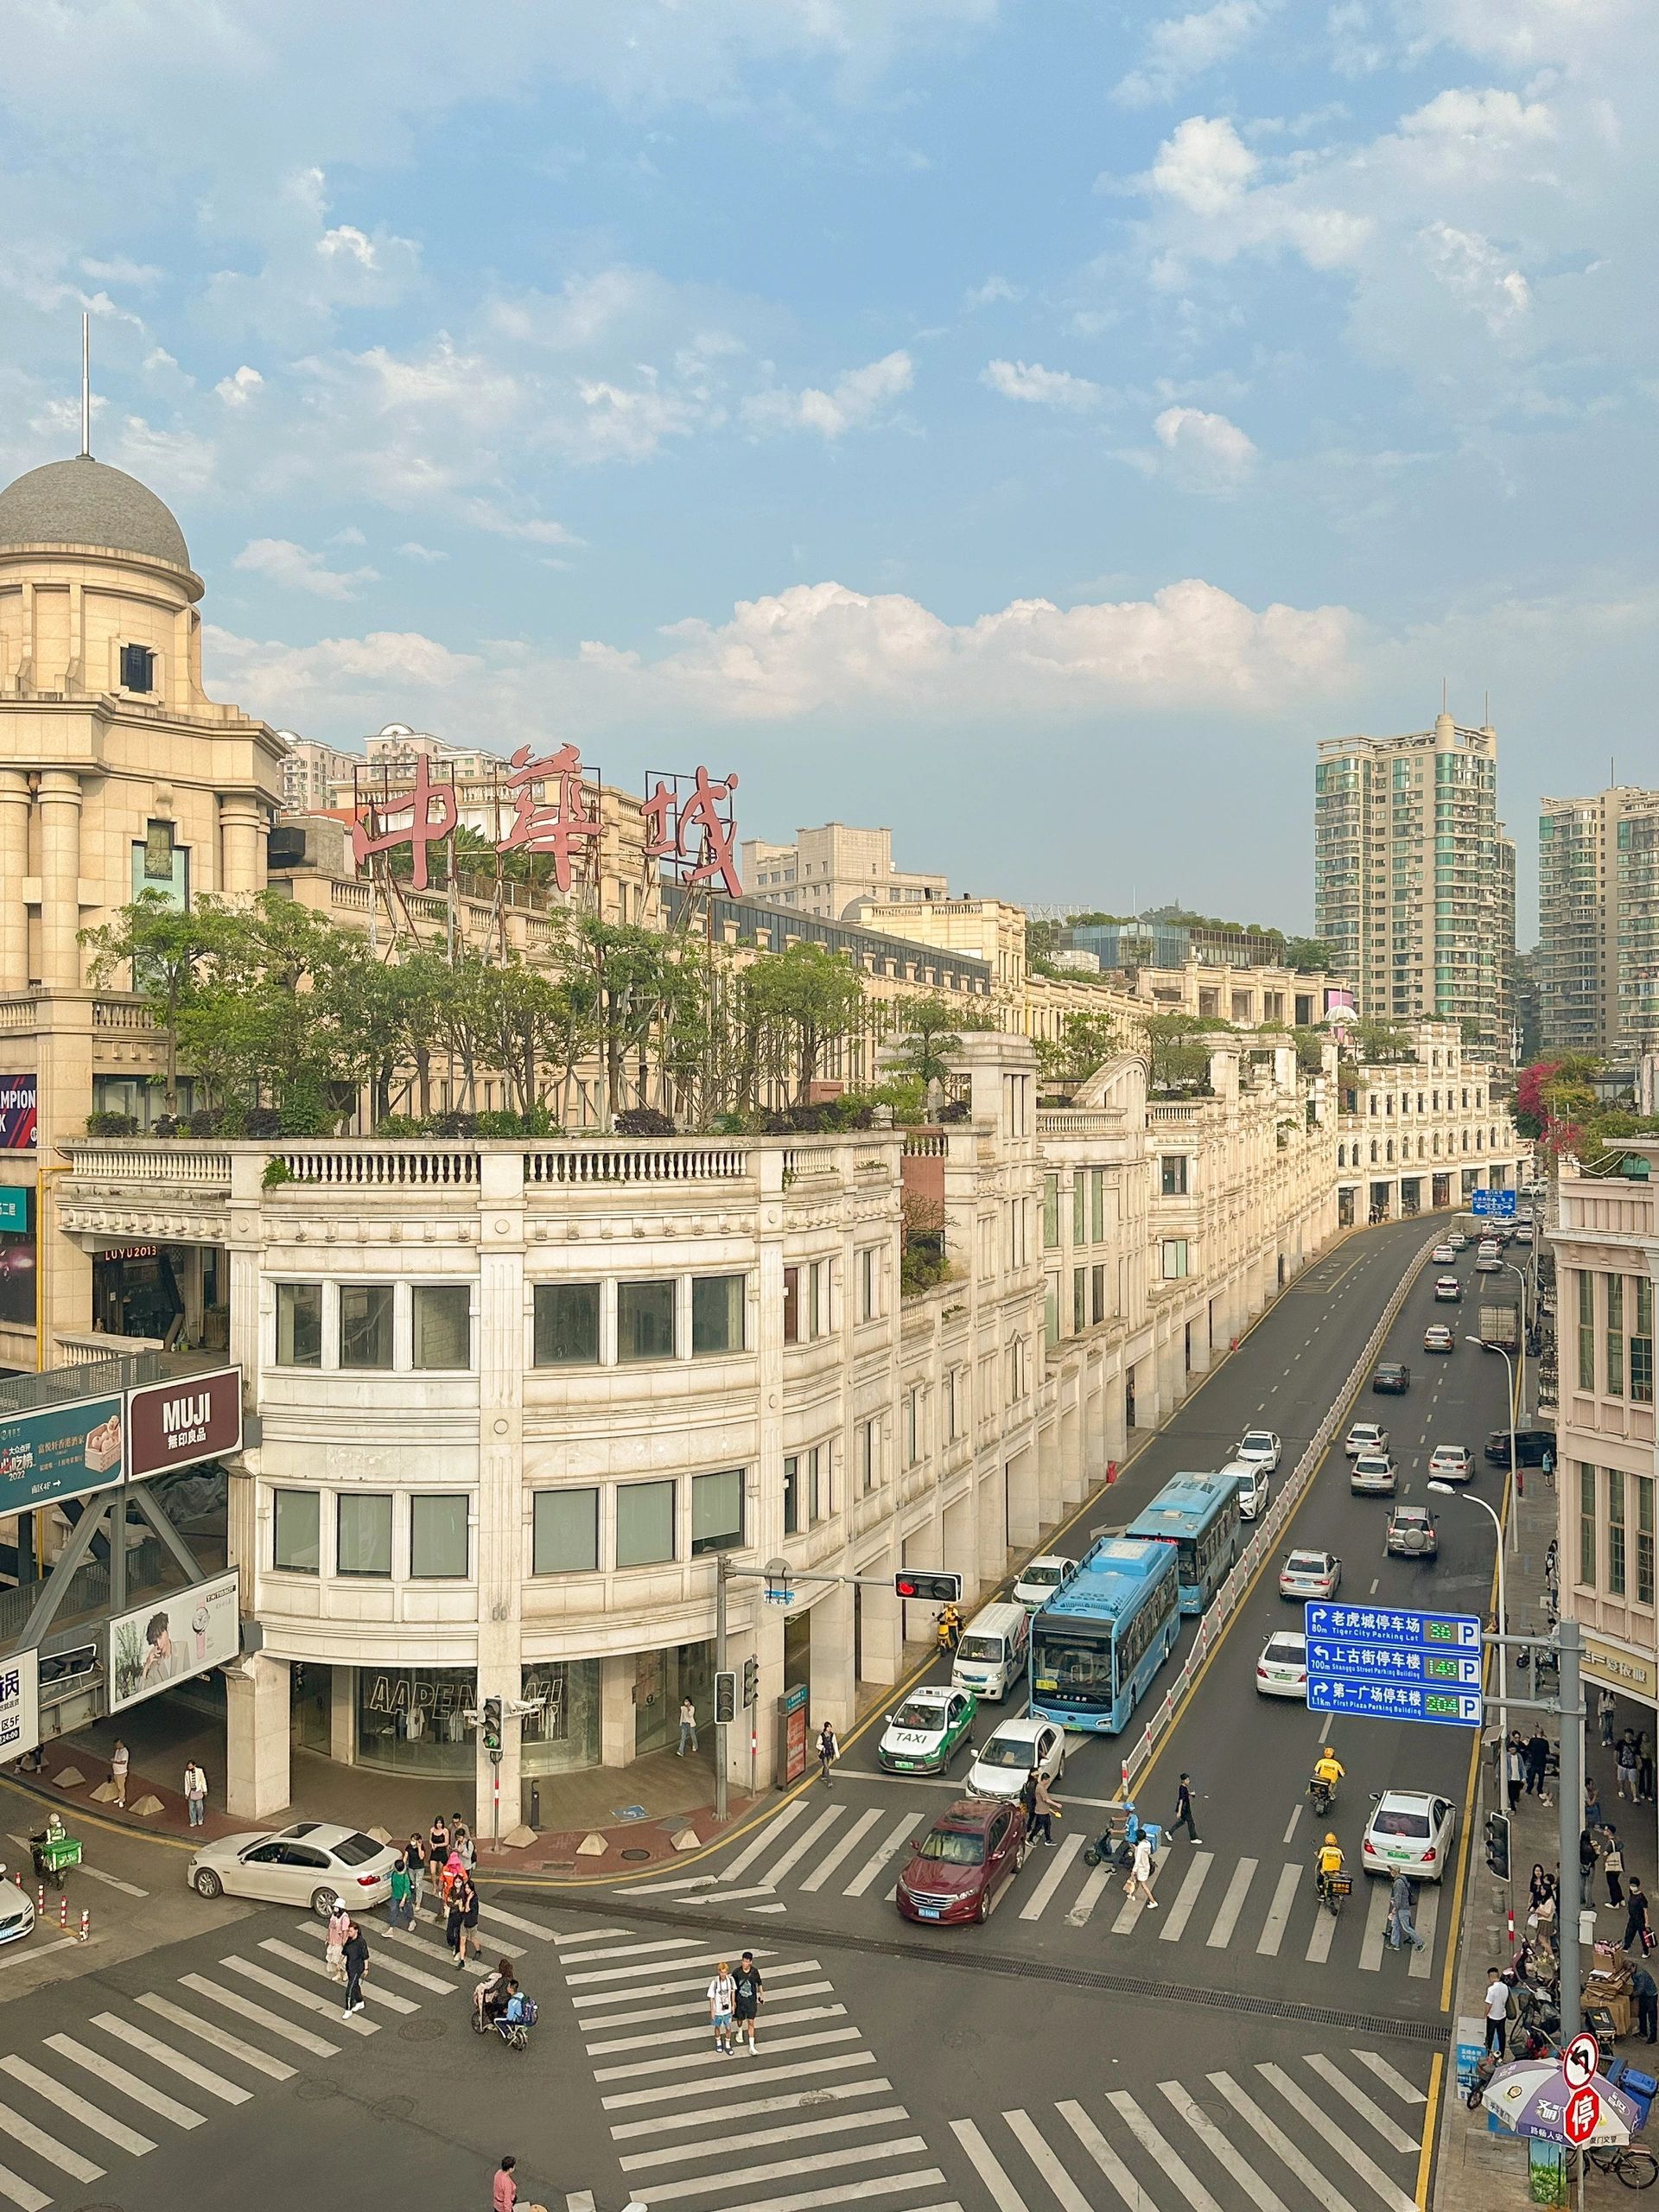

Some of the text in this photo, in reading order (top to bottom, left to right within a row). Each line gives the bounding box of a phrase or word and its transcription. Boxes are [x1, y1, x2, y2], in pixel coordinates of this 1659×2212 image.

[0, 1090, 36, 1109] MPION
[105, 1245, 156, 1261] LUYU2013
[162, 1392, 211, 1433] MUJI
[168, 1427, 207, 1450] 無印良品
[9, 1442, 31, 1456] 大众点评
[9, 1470, 25, 1482] 2022
[1312, 1624, 1327, 1634] 80m
[1332, 1611, 1421, 1633] 老虎城停车场
[1332, 1627, 1352, 1636] Tiger
[1354, 1630, 1370, 1638] City
[1372, 1630, 1404, 1641] Parking
[1463, 1625, 1474, 1643] P
[1332, 1646, 1421, 1669] 上古街停车楼
[1374, 1668, 1395, 1676] Parking
[1396, 1669, 1421, 1679] Building
[1429, 1660, 1457, 1676] 140
[1465, 1662, 1475, 1681] P
[1333, 1681, 1421, 1707] 第一广场停车楼
[1368, 1704, 1393, 1713] Parking
[1394, 1706, 1421, 1716] Building
[1465, 1699, 1476, 1718] P
[896, 1732, 927, 1745] TAXI
[1572, 2094, 1594, 2137] 停
